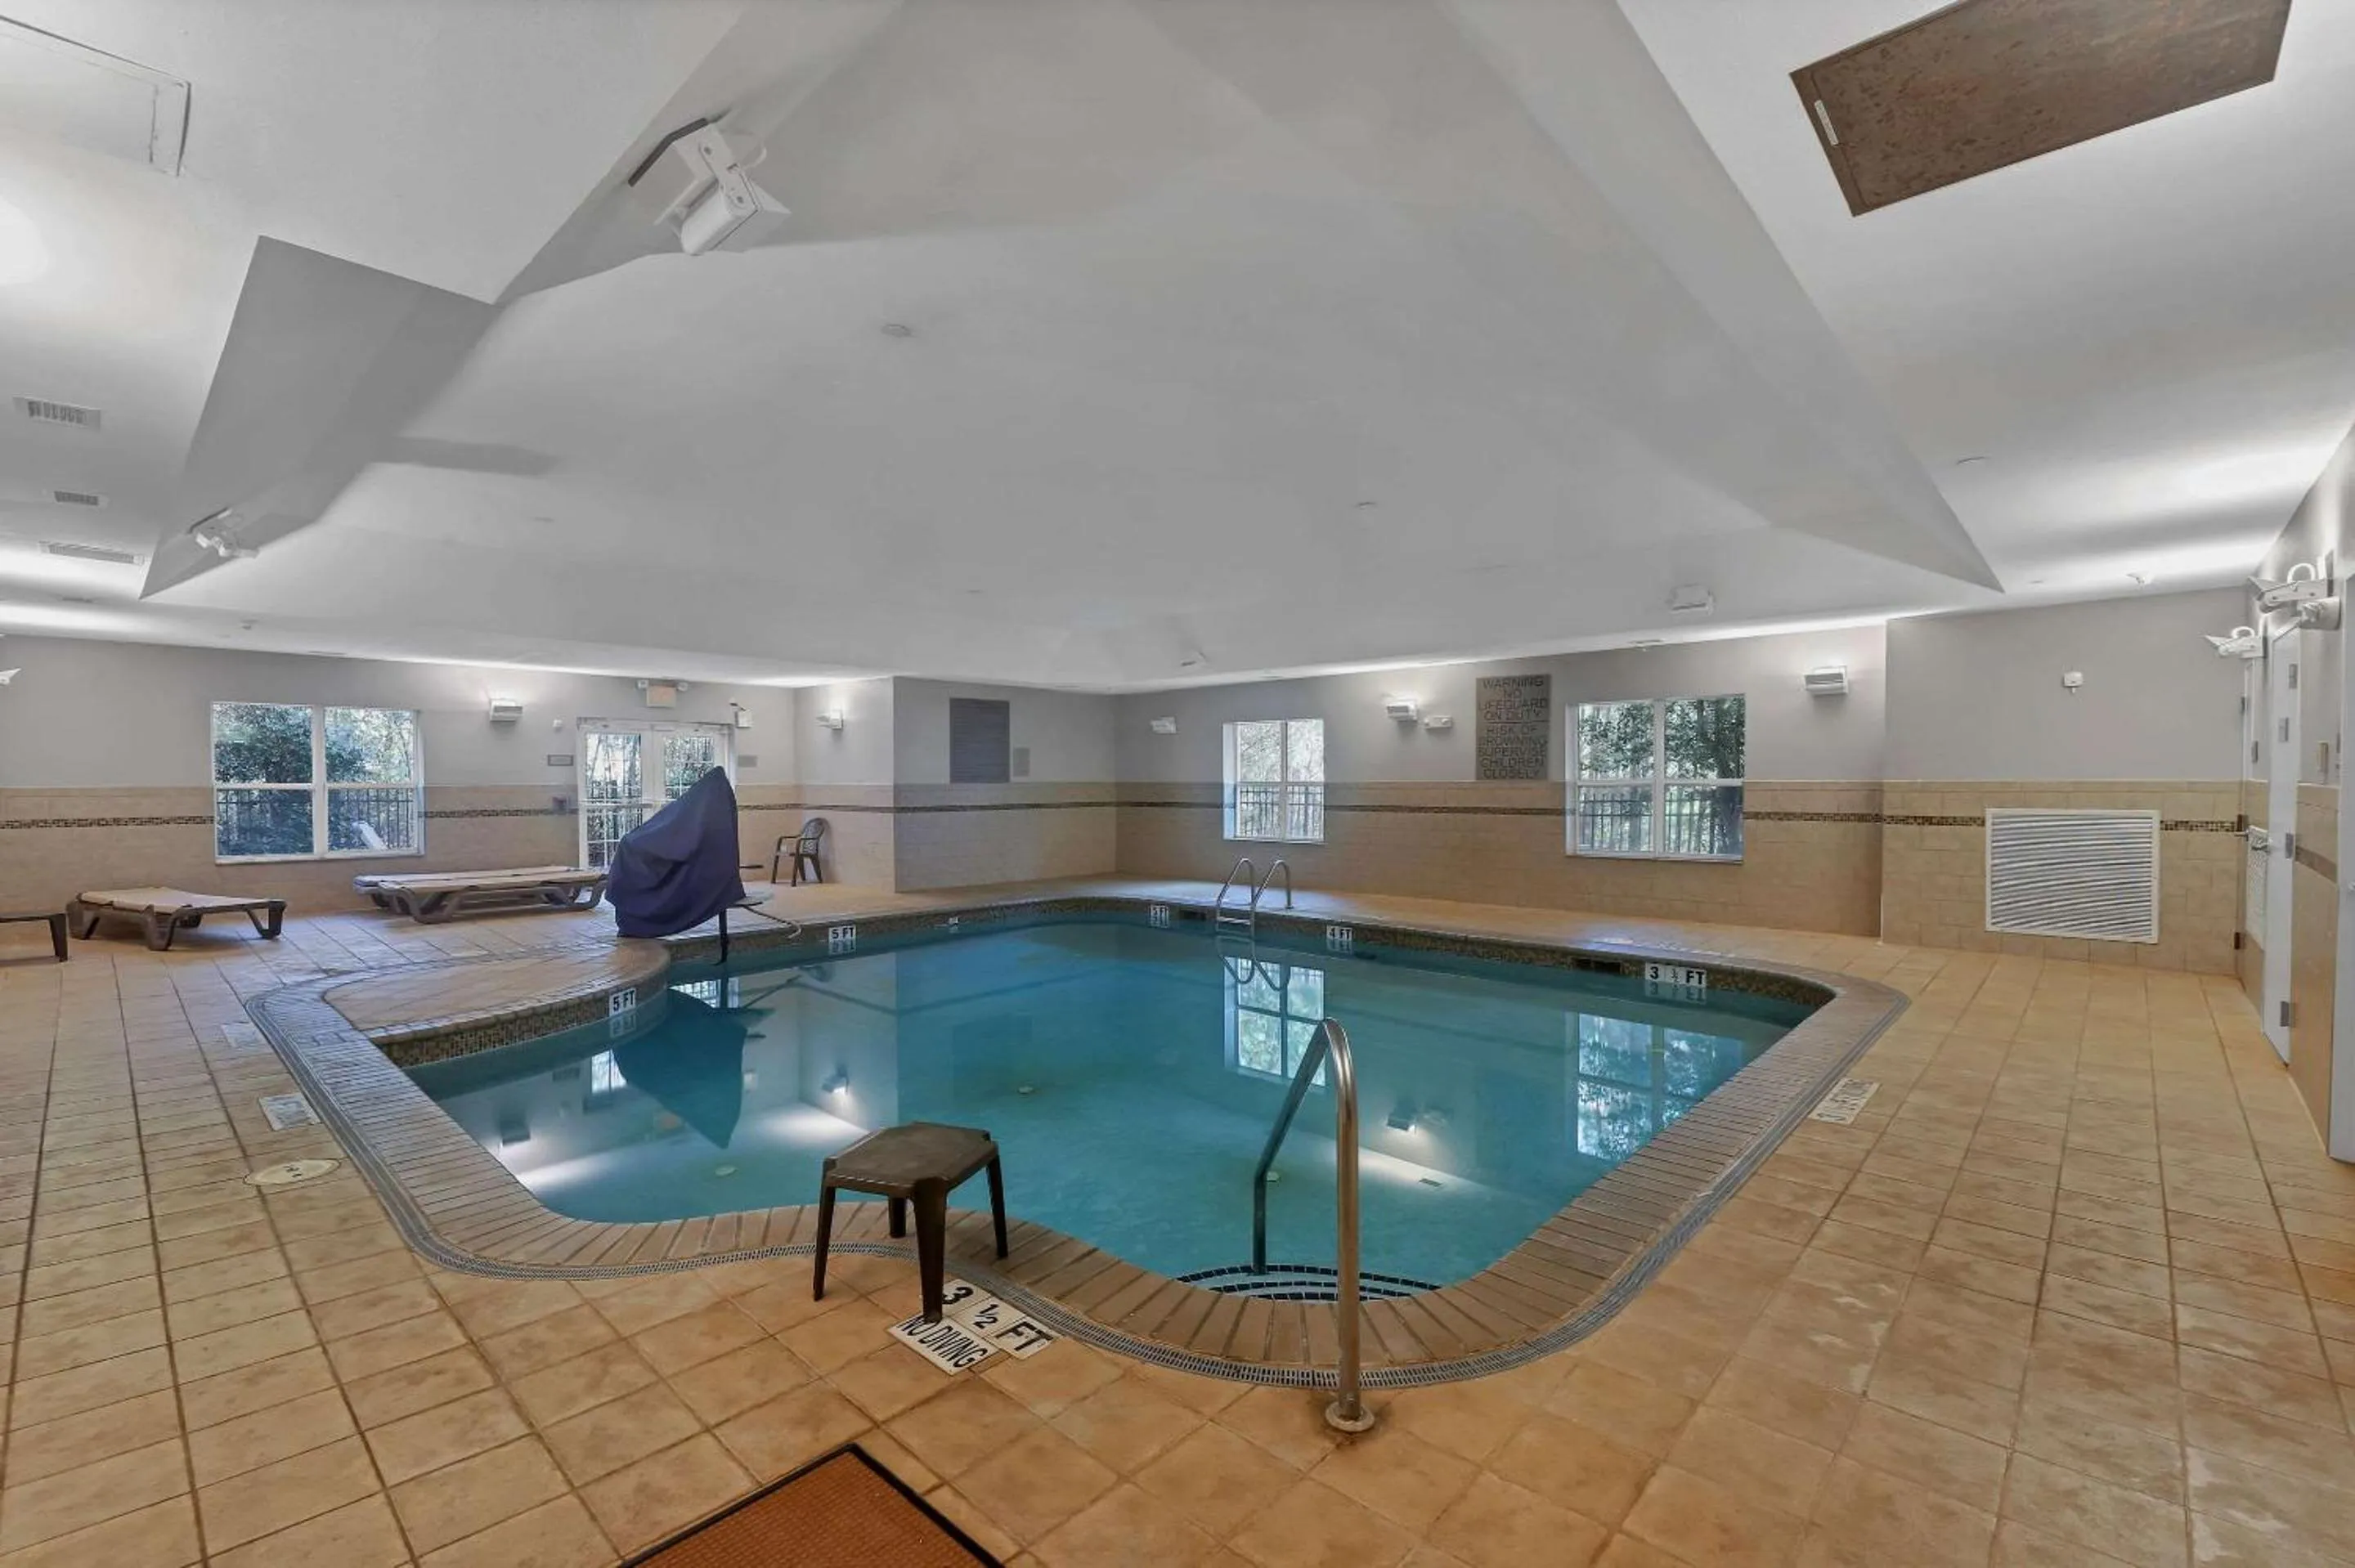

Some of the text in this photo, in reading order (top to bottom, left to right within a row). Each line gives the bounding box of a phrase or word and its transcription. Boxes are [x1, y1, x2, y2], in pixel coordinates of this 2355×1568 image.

[1483, 676, 1545, 689] WARNING
[1503, 688, 1522, 700] NO
[1478, 697, 1549, 711] LIFEGUARD
[1481, 756, 1544, 768] CHILDREN
[1483, 768, 1541, 779] CLOSELY
[831, 927, 854, 939] 5 FT
[1339, 928, 1351, 939] FT
[1649, 966, 1659, 980] 3
[1686, 970, 1705, 985] FT
[613, 989, 635, 1012] 5 FT
[941, 1286, 974, 1305] 3
[994, 1320, 1055, 1351] FT
[899, 1314, 988, 1368] NO DIVING
